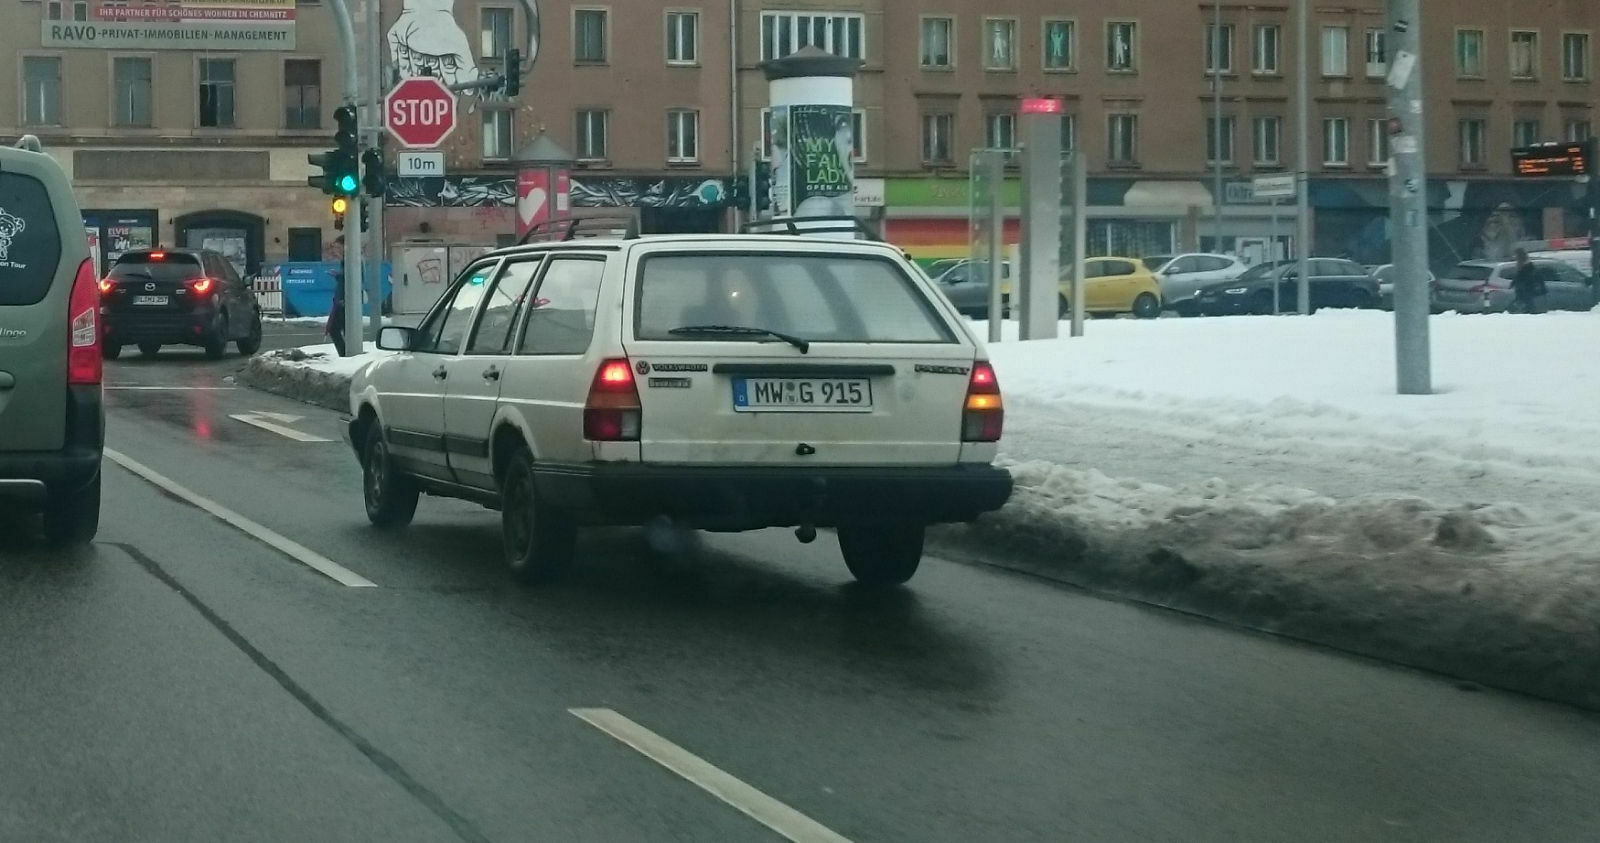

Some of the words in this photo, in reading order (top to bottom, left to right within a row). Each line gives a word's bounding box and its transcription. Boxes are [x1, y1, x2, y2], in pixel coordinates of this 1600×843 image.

[115, 8, 150, 17] PARTNER
[169, 9, 202, 17] SCHÖNES
[392, 99, 448, 126] STOP
[806, 137, 834, 152] MY
[408, 157, 435, 170] 10m
[806, 168, 848, 183] LADY
[11, 261, 26, 269] Tour
[651, 363, 708, 372] VOLKSWAGEN
[755, 382, 784, 403] MW
[799, 382, 815, 403] G
[821, 382, 862, 404] 915
